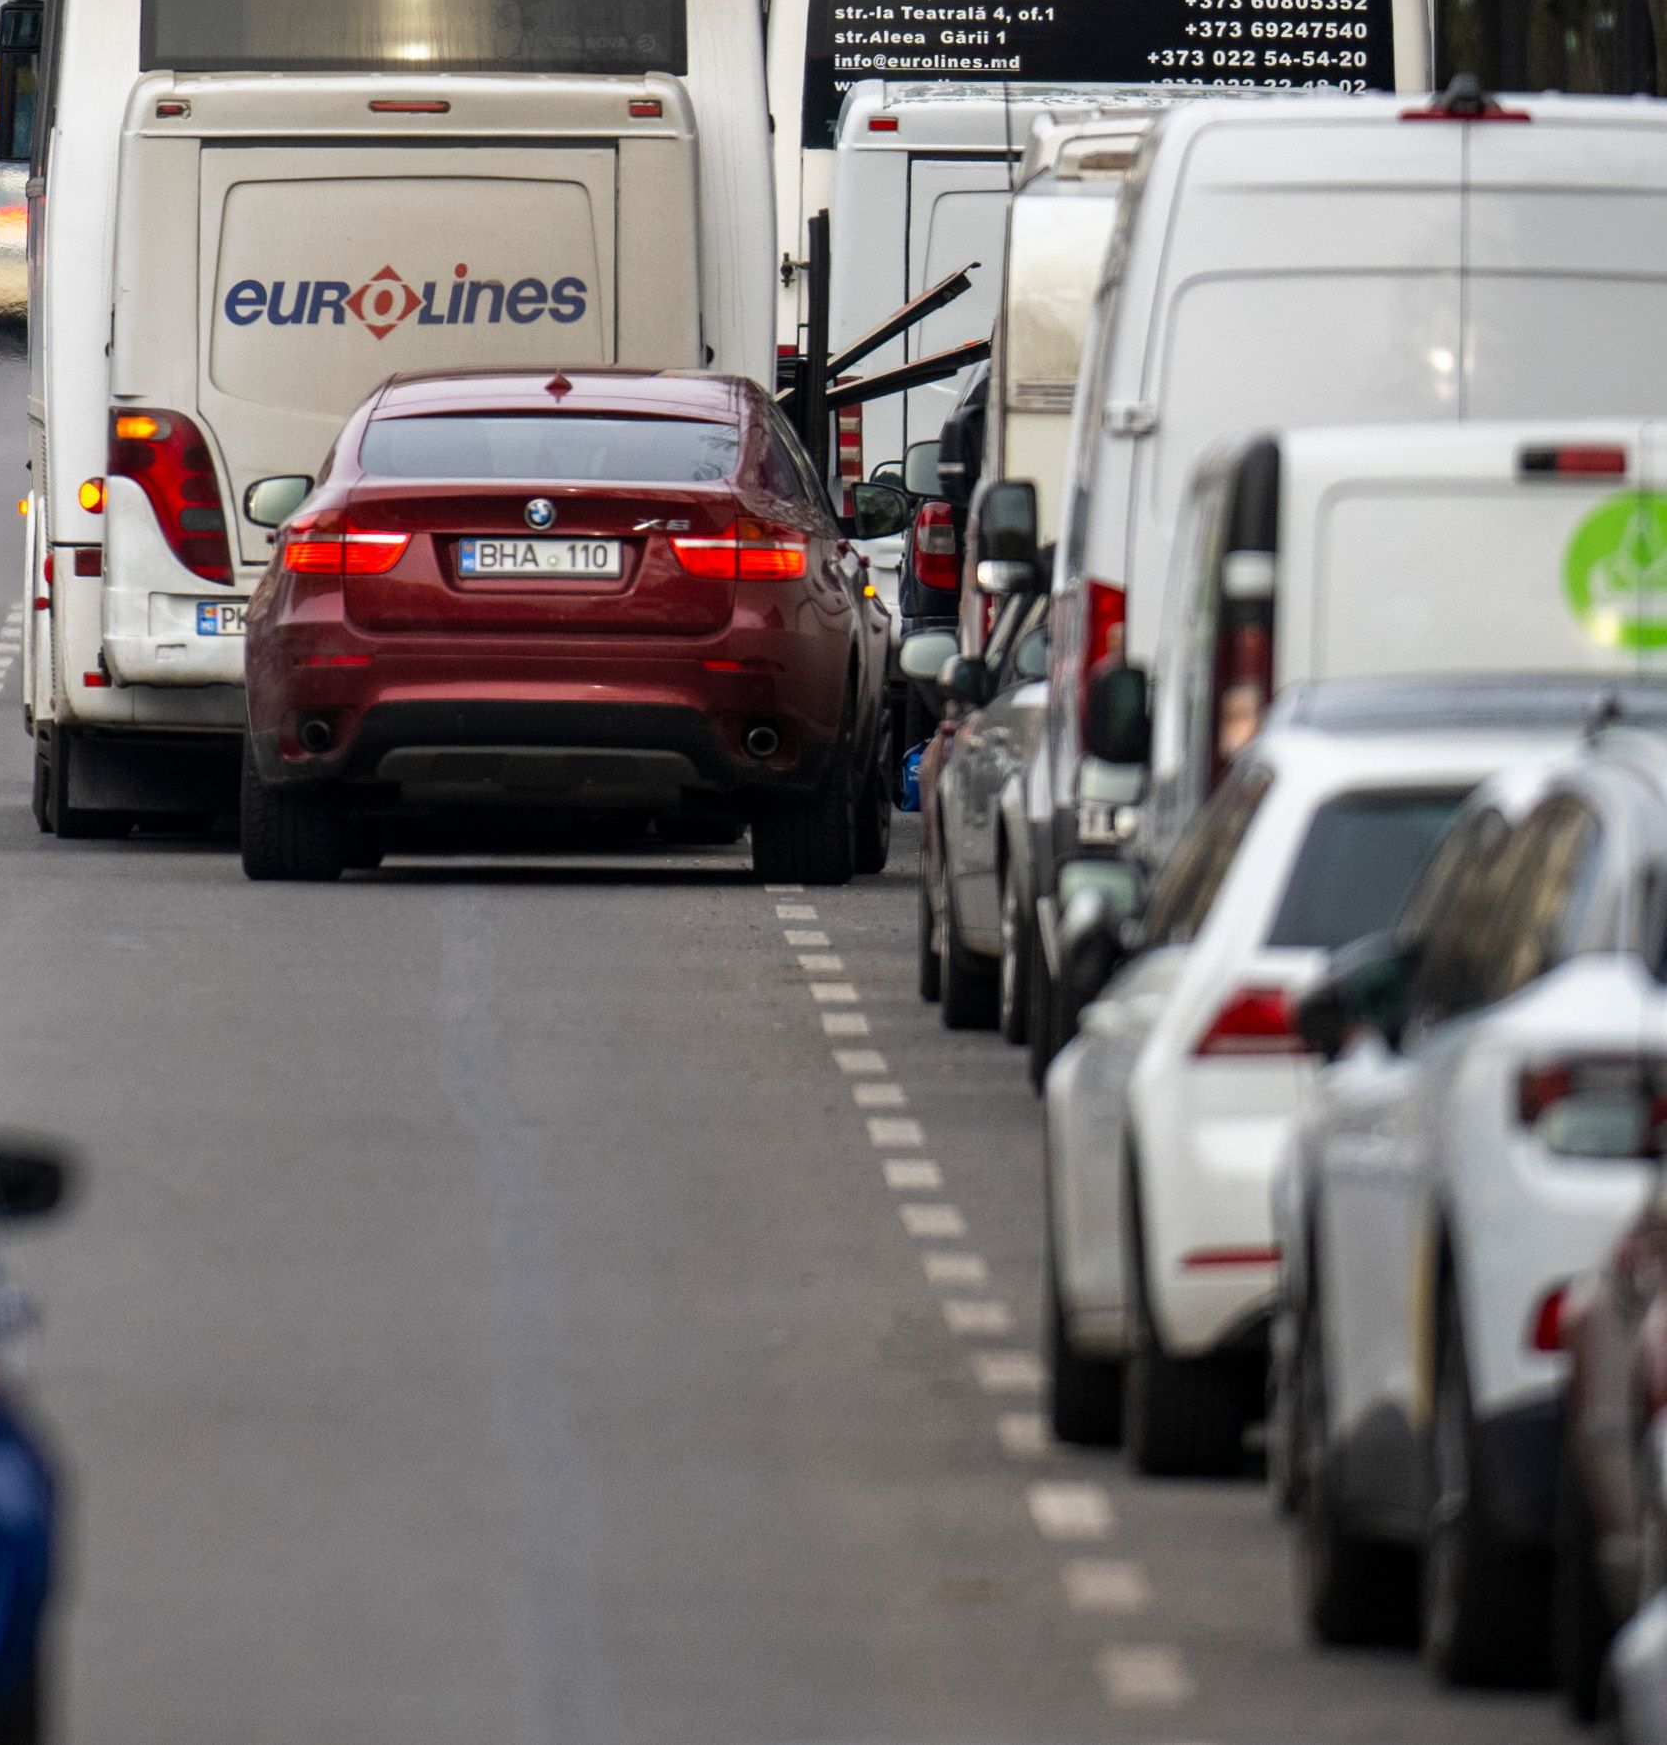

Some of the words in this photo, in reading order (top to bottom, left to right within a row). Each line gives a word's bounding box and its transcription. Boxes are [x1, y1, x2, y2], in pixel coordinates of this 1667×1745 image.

[835, 6, 894, 20] str.-la
[900, 6, 987, 21] Teatrală
[993, 7, 1012, 24] 4,
[1018, 7, 1054, 22] of.1
[940, 31, 989, 45] Gării
[996, 31, 1006, 45] 1
[1185, 22, 1243, 38] +373
[1250, 22, 1368, 39] 69247540
[834, 54, 1020, 71] info@eurolines.md
[1147, 50, 1204, 66] +373
[1213, 51, 1256, 66] 022
[1263, 51, 1367, 67] 54-54-20
[479, 544, 539, 569] BHA
[567, 544, 609, 568] 110
